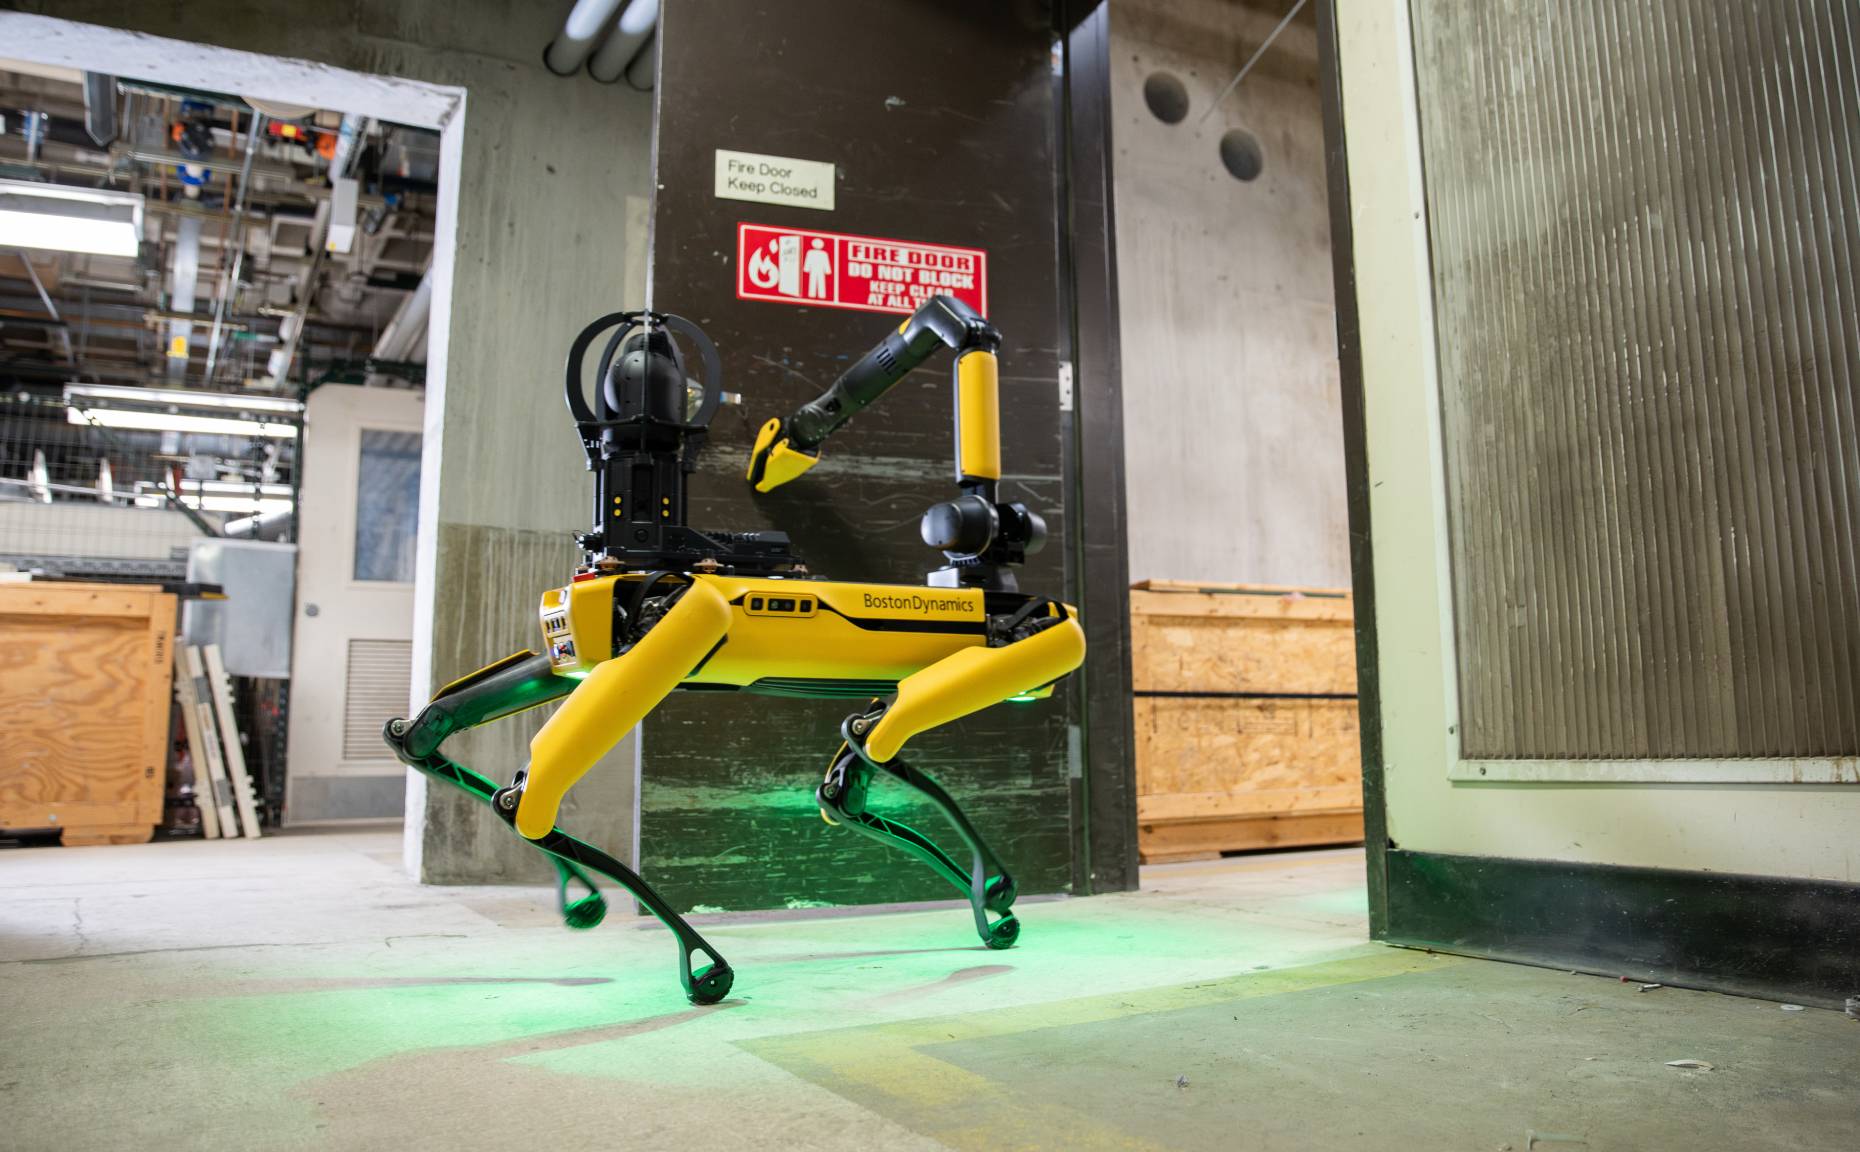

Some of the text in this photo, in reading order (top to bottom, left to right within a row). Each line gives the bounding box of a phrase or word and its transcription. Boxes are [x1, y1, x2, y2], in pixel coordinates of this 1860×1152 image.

[728, 159, 792, 178] Fire Door
[728, 177, 818, 199] Keep Closed
[852, 244, 970, 271] FIRE DOOR
[848, 262, 974, 290] DO NOT BLOCK
[869, 280, 906, 294] KEEP
[867, 293, 885, 306] AT
[887, 295, 912, 309] ALL
